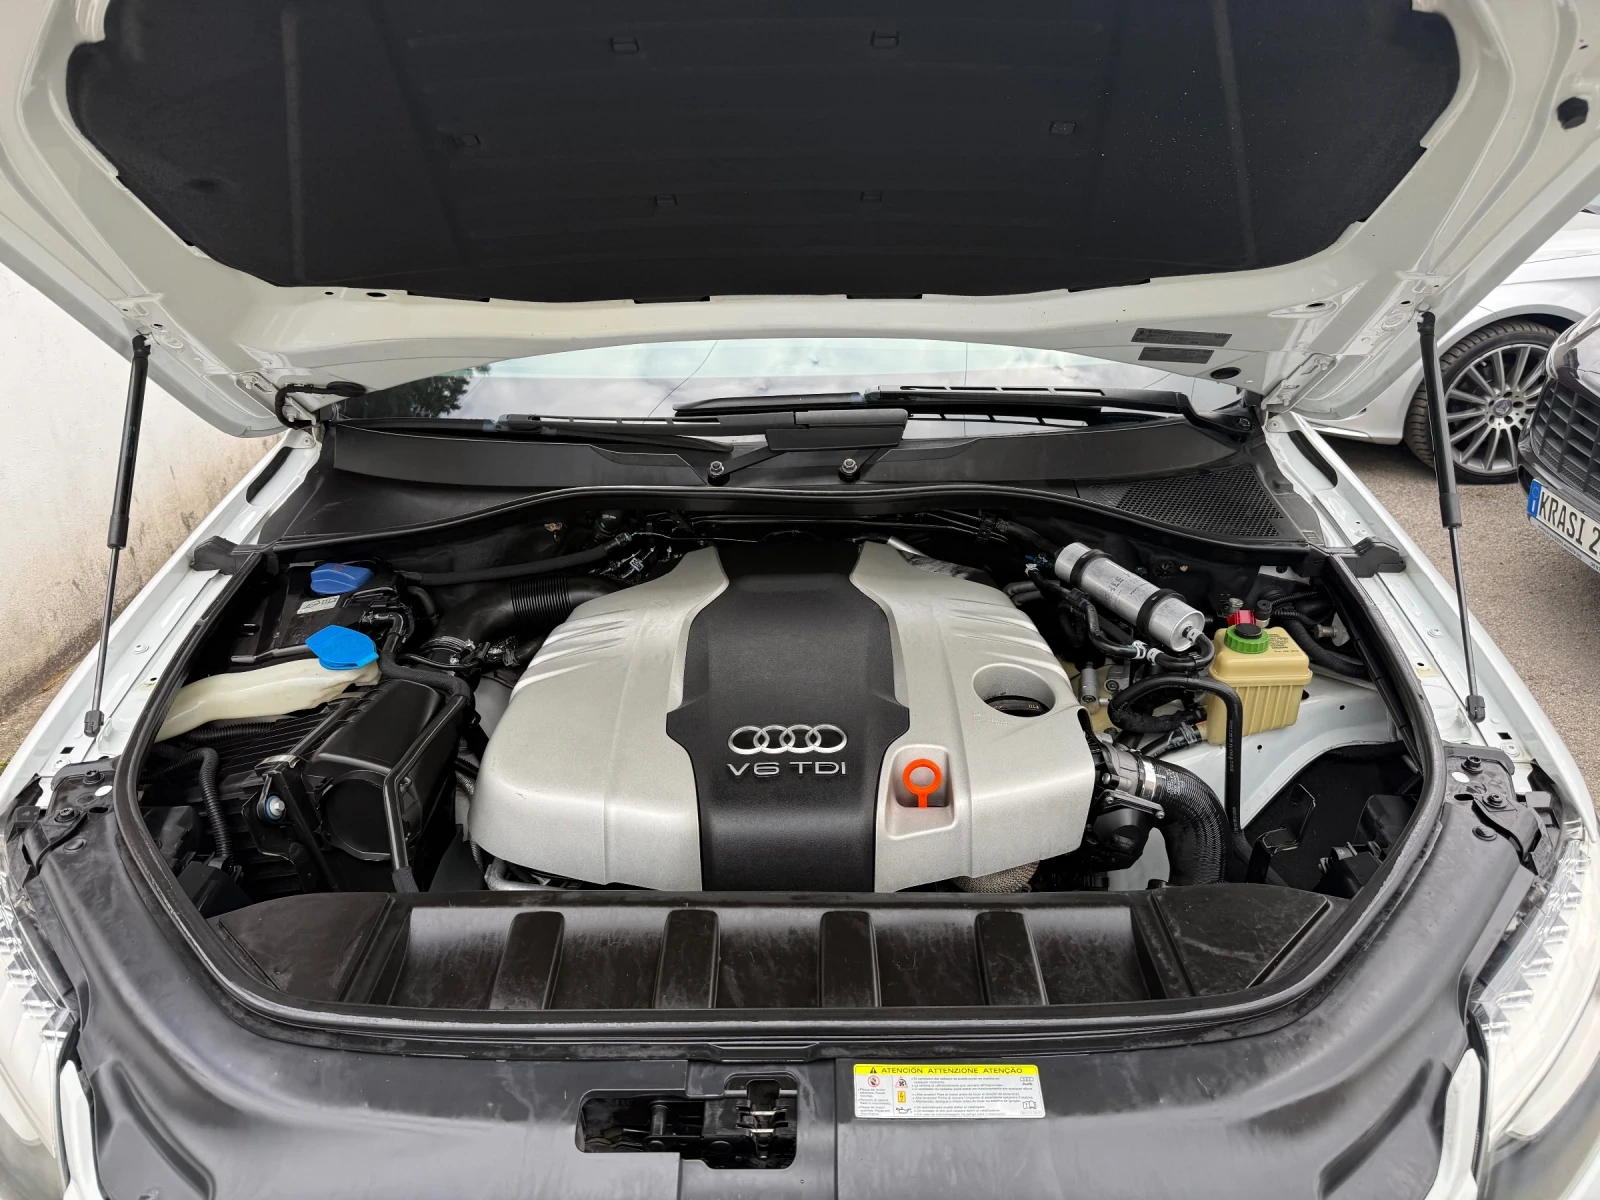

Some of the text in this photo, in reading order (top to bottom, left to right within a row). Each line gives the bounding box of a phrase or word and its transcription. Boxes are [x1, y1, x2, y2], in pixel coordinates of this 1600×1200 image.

[1539, 491, 1586, 546] KRASI
[727, 761, 846, 776] V6 TDI
[983, 1067, 1023, 1075] ATENÇÃO
